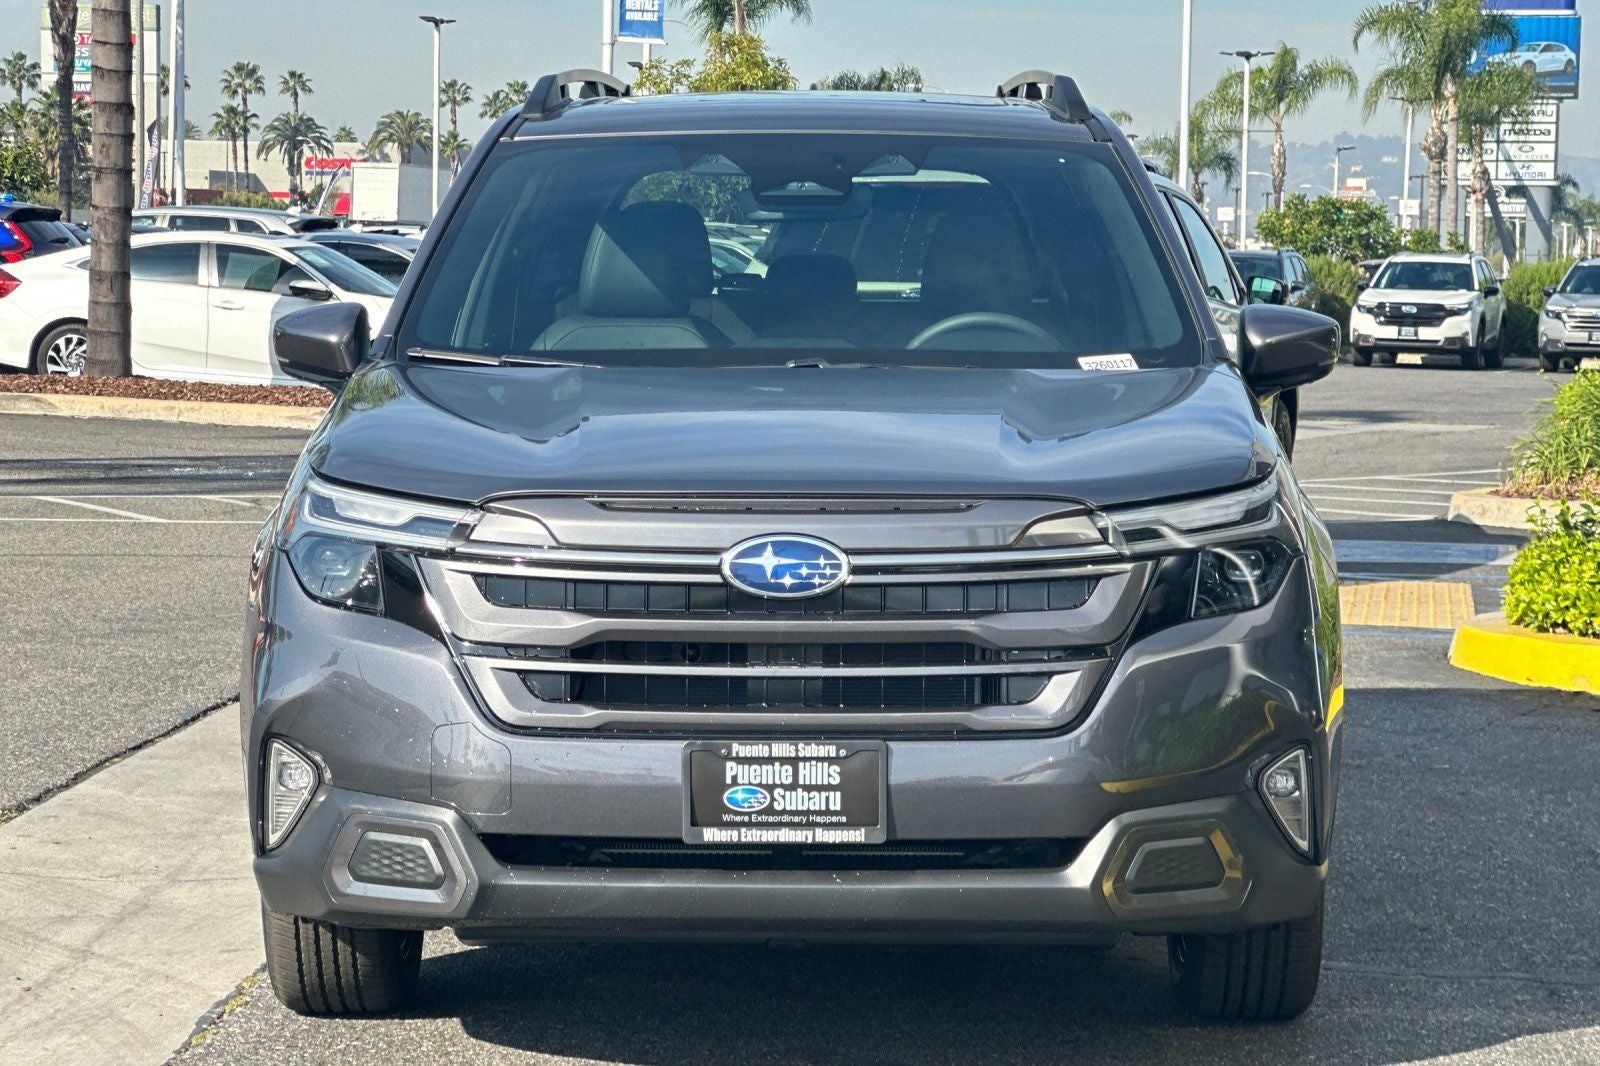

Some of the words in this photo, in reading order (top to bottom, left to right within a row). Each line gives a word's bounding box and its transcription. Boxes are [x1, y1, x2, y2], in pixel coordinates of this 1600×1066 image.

[625, 0, 659, 10] RENTALS
[625, 11, 659, 21] AVAILABLE
[1505, 171, 1547, 179] HYUNDAI
[731, 743, 770, 758] Puente
[771, 743, 796, 758] Hills
[797, 743, 837, 758] Subaru
[725, 761, 793, 785] Puente
[798, 760, 841, 785] Hills
[773, 788, 841, 811] Subaru
[722, 814, 750, 823] Where
[751, 813, 807, 825] Extraordinary
[809, 814, 847, 824] Happens
[703, 828, 739, 842] Where
[740, 828, 813, 844] Extraordinary
[815, 828, 865, 844] Happens!
